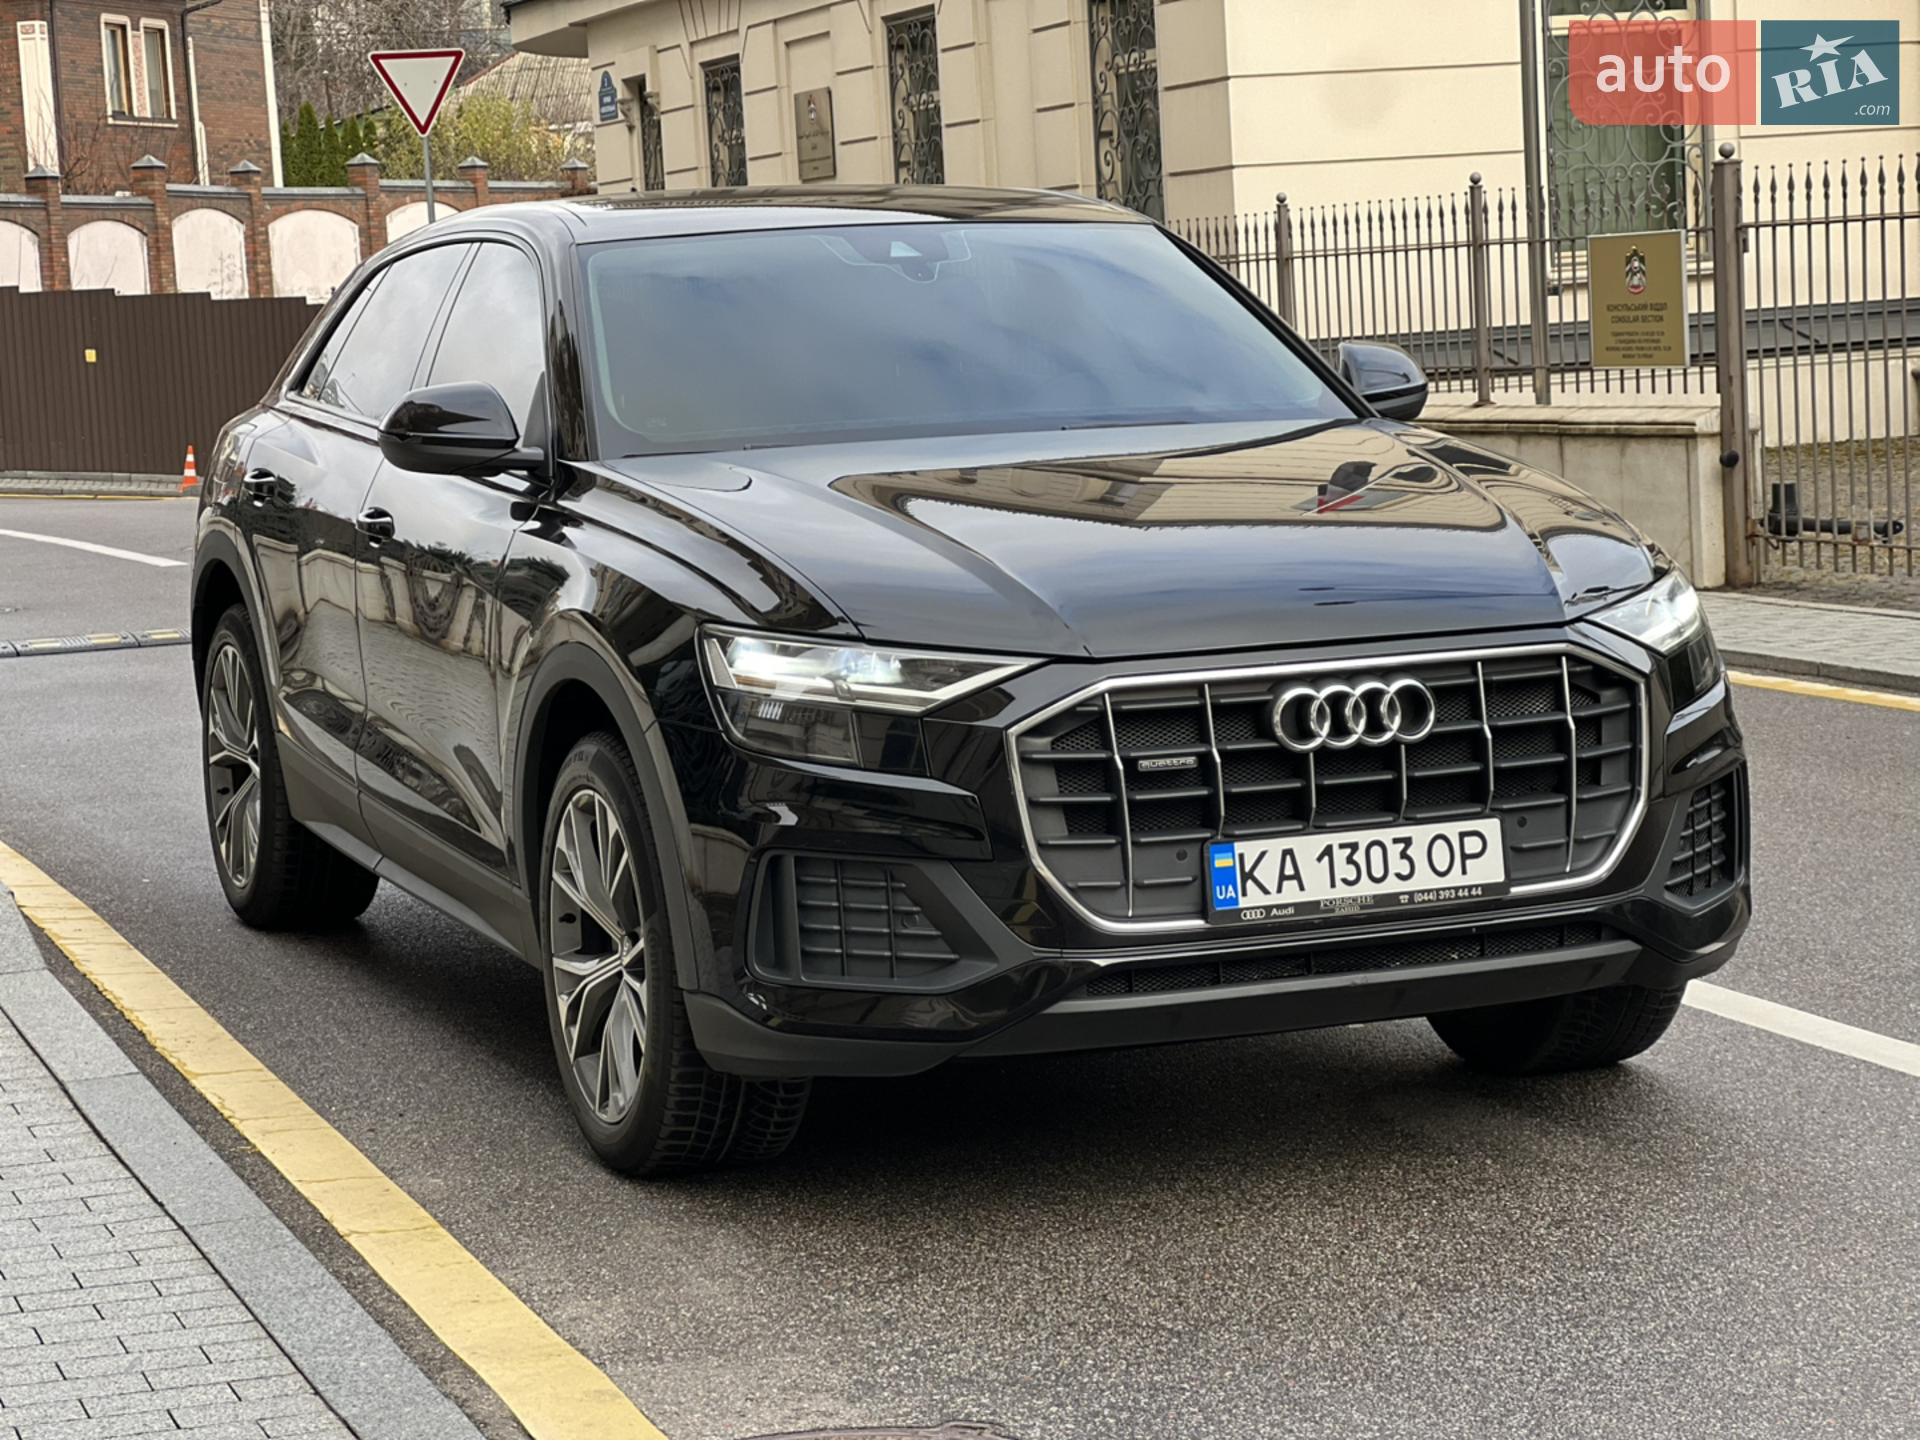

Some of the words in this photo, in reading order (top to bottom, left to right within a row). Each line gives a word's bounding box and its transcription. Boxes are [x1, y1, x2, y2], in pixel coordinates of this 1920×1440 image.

[1238, 847, 1306, 897] KA
[1315, 836, 1416, 889] 1303
[1427, 830, 1487, 877] OP
[1216, 884, 1236, 899] UA
[1413, 891, 1437, 903] (044)
[1438, 889, 1456, 900] 393
[1457, 887, 1469, 898] 44
[1470, 886, 1483, 896] 44
[1270, 905, 1295, 917] Audi
